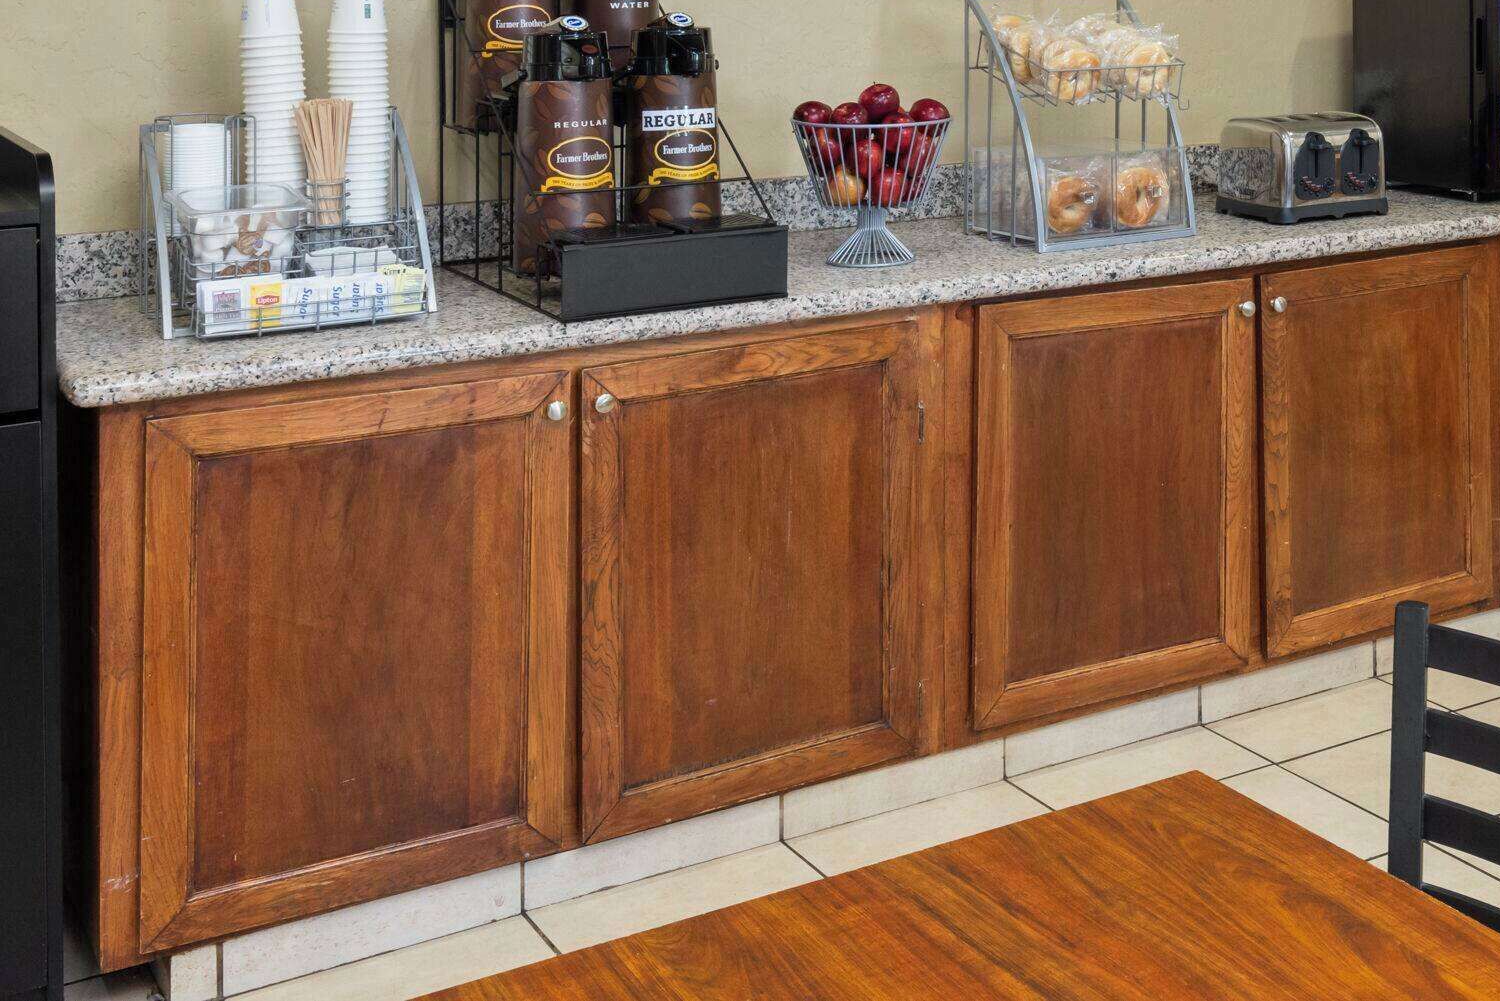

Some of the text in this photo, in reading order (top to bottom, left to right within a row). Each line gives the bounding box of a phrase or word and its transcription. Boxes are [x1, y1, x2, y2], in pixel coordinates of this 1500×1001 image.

[609, 1, 650, 9] WATER
[495, 19, 519, 29] Farmer
[554, 119, 608, 129] REGULAR
[643, 112, 714, 128] REGULAR
[662, 142, 713, 155] Farmer Brothers
[556, 150, 608, 164] Farmer Brothers
[257, 296, 278, 305] Lipton
[298, 286, 313, 320] Sugar
[331, 284, 343, 317] Sugar
